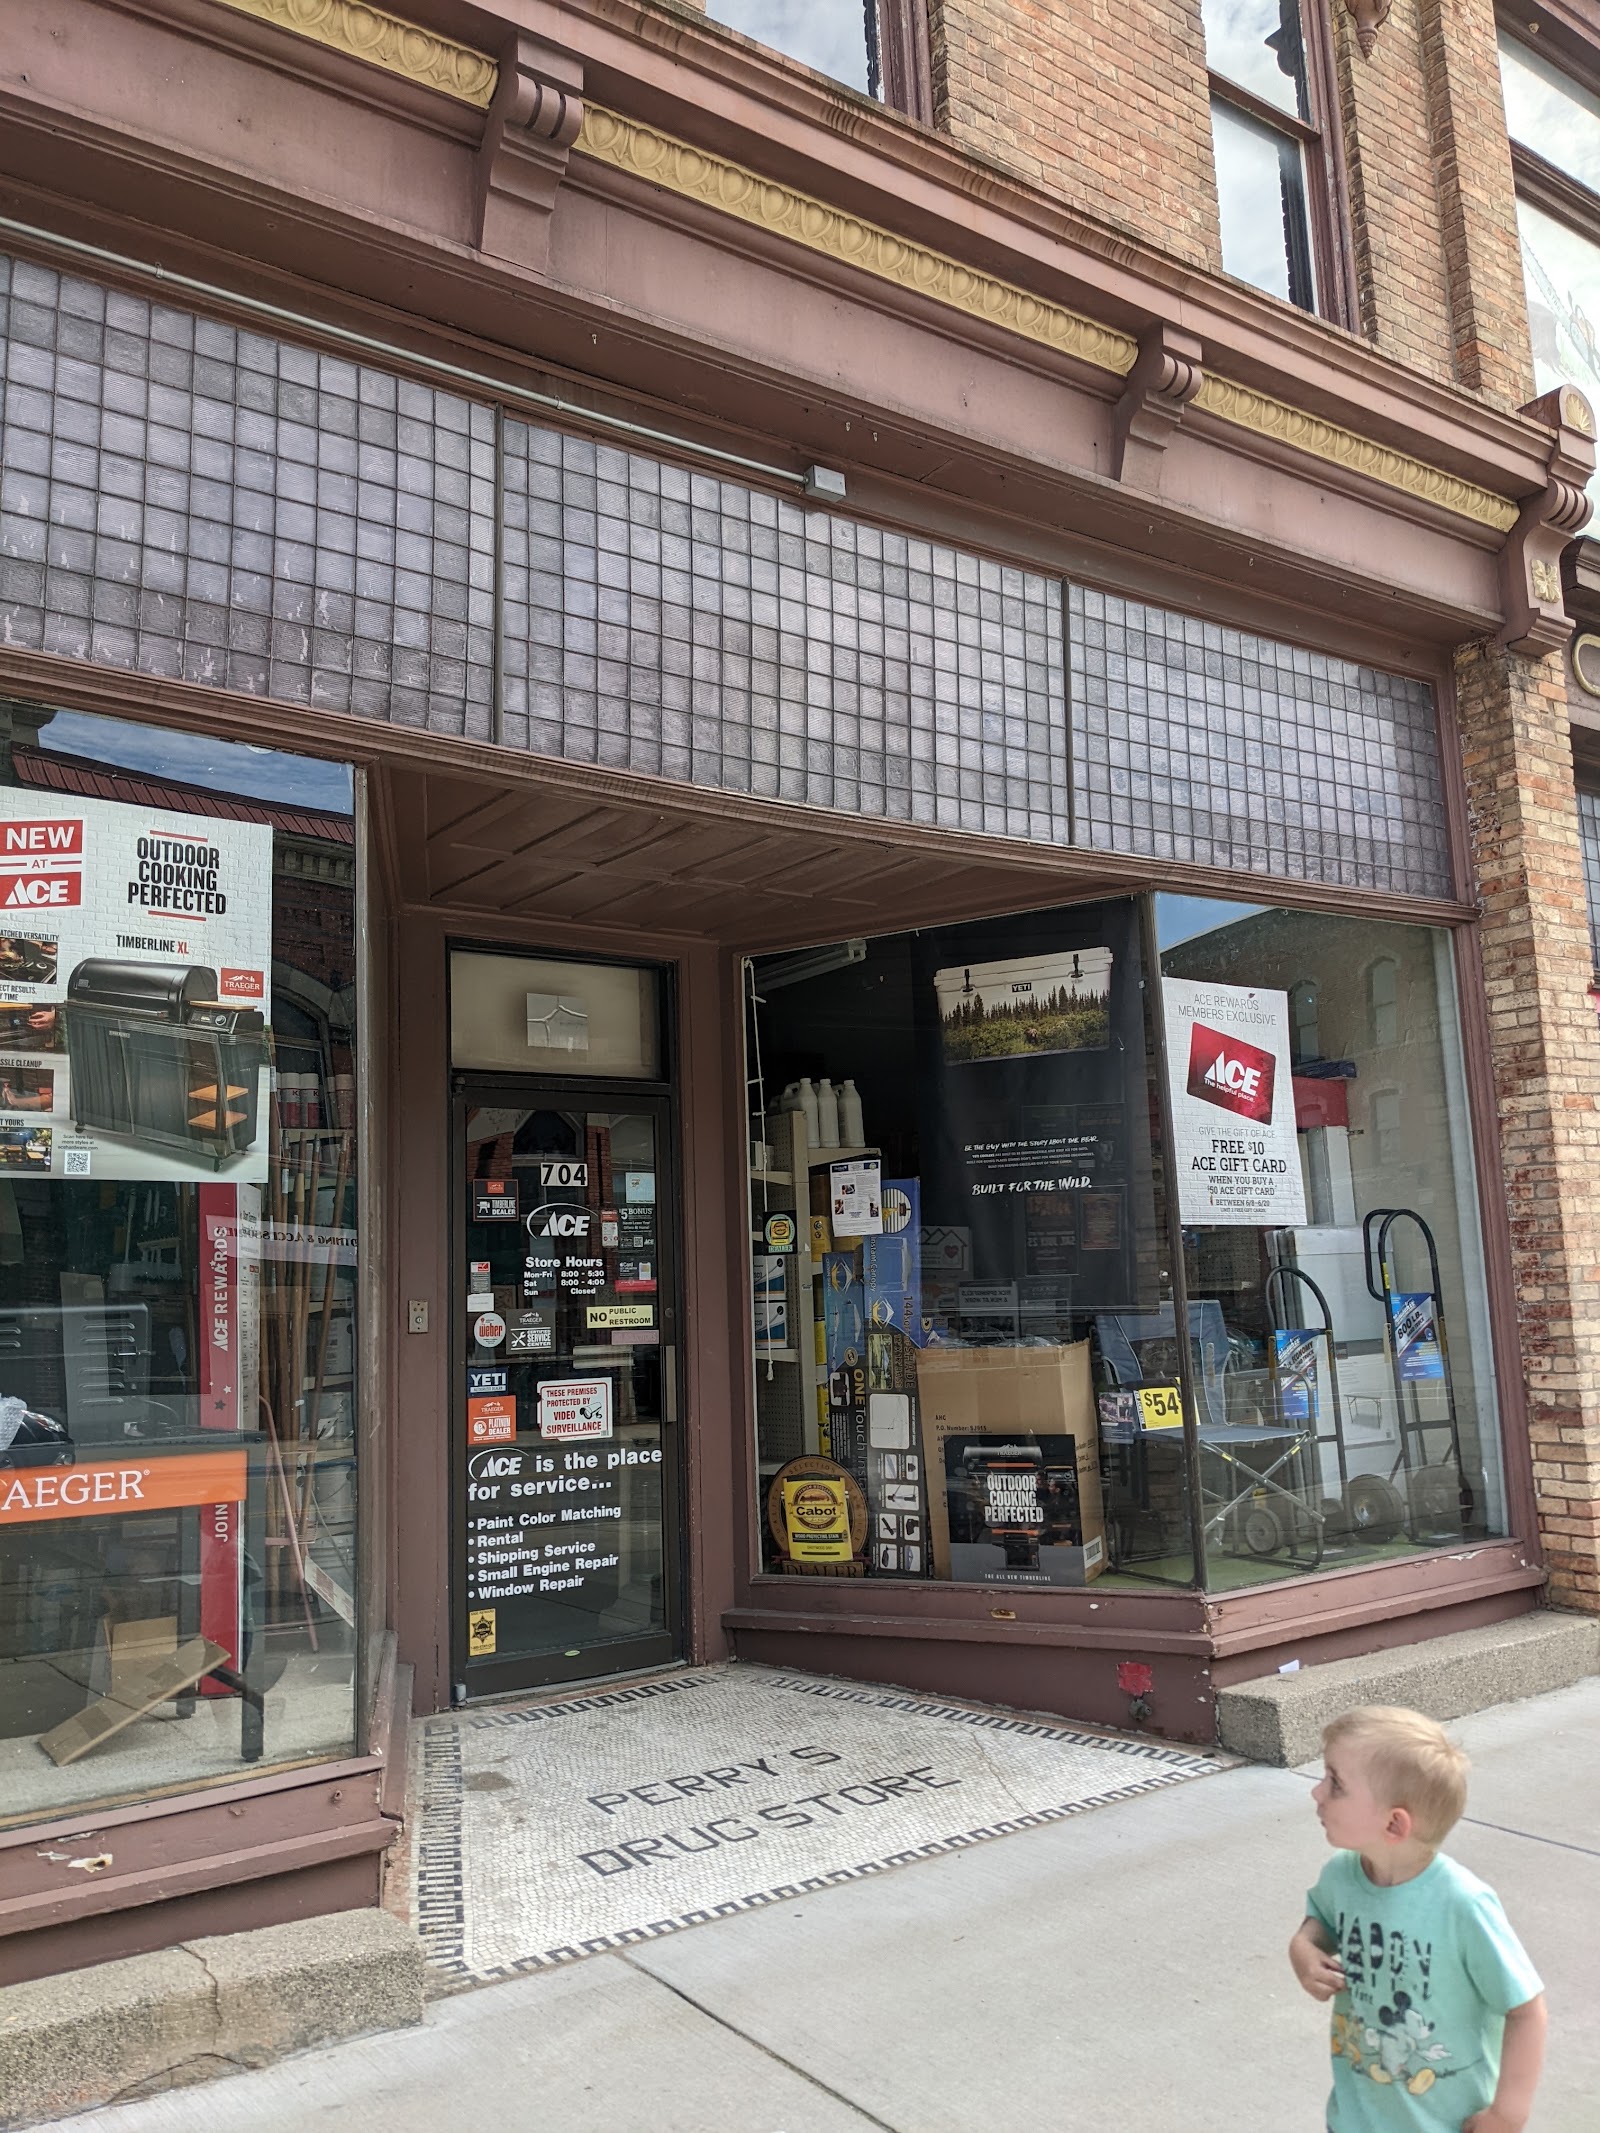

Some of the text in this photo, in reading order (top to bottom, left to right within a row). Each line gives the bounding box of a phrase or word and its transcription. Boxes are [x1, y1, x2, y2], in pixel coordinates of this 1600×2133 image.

[6, 826, 74, 850] NEW
[137, 837, 219, 869] OUTDOOR
[31, 859, 48, 869] AT
[138, 861, 217, 892] COOKING
[7, 876, 70, 905] ACE
[127, 882, 226, 915] PERFECTED
[23, 931, 59, 942] VERSATILITY
[116, 934, 189, 954] TIMBERLINE XL
[11, 986, 37, 995] RESULTS,
[224, 980, 260, 991] TRAEGER
[1012, 983, 1031, 992] YETI
[4, 993, 19, 1001] TIME
[1194, 993, 1259, 1011] ACE REWARDS
[1178, 1005, 1277, 1026] MEMBERS EXCLUSIVE
[16, 1059, 42, 1068] CLEANUP
[1204, 1051, 1261, 1096] ACE
[1204, 1077, 1215, 1087] The
[1216, 1082, 1237, 1097] helpful
[5, 1118, 24, 1127] YOURS
[1199, 1126, 1276, 1138] GIVE THE GIFT OF ACE
[1212, 1139, 1264, 1155] FREE $10
[1191, 1156, 1286, 1173] ACE GIFT CARD
[542, 1164, 586, 1185] 704
[1209, 1175, 1274, 1186] WHEN YOU BUY A
[972, 1175, 1092, 1196] BUILT FOR THE WILD.
[1220, 1186, 1234, 1195] ACE
[1236, 1186, 1253, 1195] GIFT
[1216, 1198, 1244, 1206] BETWEEN
[492, 1208, 516, 1216] DEALER
[628, 1207, 652, 1216] BONUS
[540, 1211, 590, 1237] ACE
[525, 1256, 603, 1268] Store Hours
[524, 1271, 553, 1279] Mon-Fri
[561, 1270, 579, 1278] 8:00
[212, 1226, 229, 1351] ACE REWARDS
[524, 1279, 537, 1287] Sat
[561, 1279, 579, 1287] 8:00
[524, 1287, 596, 1296] Sun Closed
[589, 1307, 637, 1323] NO PUBLIC
[609, 1317, 651, 1326] RESTROOM
[479, 1323, 503, 1337] weber
[1397, 1318, 1411, 1340] 800
[527, 1333, 551, 1343] SERVICE
[1291, 1341, 1313, 1363] ECONOMY
[903, 1346, 915, 1389] SHADE
[470, 1372, 506, 1386] YETI
[853, 1368, 866, 1406] ONE
[547, 1387, 597, 1398] THESE PREMISES
[547, 1397, 590, 1408] PROTECTED BY
[489, 1416, 511, 1427] PLATINUM
[553, 1411, 575, 1421] VIDEO
[489, 1426, 511, 1435] DEALER
[546, 1421, 602, 1435] SURVEILLANCE
[855, 1406, 868, 1450] Touch
[480, 1448, 663, 1478] ACE is the place
[789, 1461, 836, 1475] SELECTION
[468, 1476, 612, 1501] for service...
[987, 1475, 1037, 1491] OUTDOOR
[989, 1491, 1036, 1506] COOKING
[478, 1505, 622, 1530] Paint Color Matching
[797, 1506, 836, 1516] Cabot
[985, 1507, 1044, 1523] PERFECTED
[214, 1503, 228, 1542] JOIN
[478, 1531, 524, 1547] Rental
[478, 1541, 596, 1565] Shipping Service
[478, 1554, 619, 1582] Small Engine Repair
[786, 1564, 858, 1577] DEALER
[478, 1575, 584, 1600] Window Repair
[586, 1745, 842, 1815] PERRY'S
[577, 1766, 962, 1877] DRUG STORE
